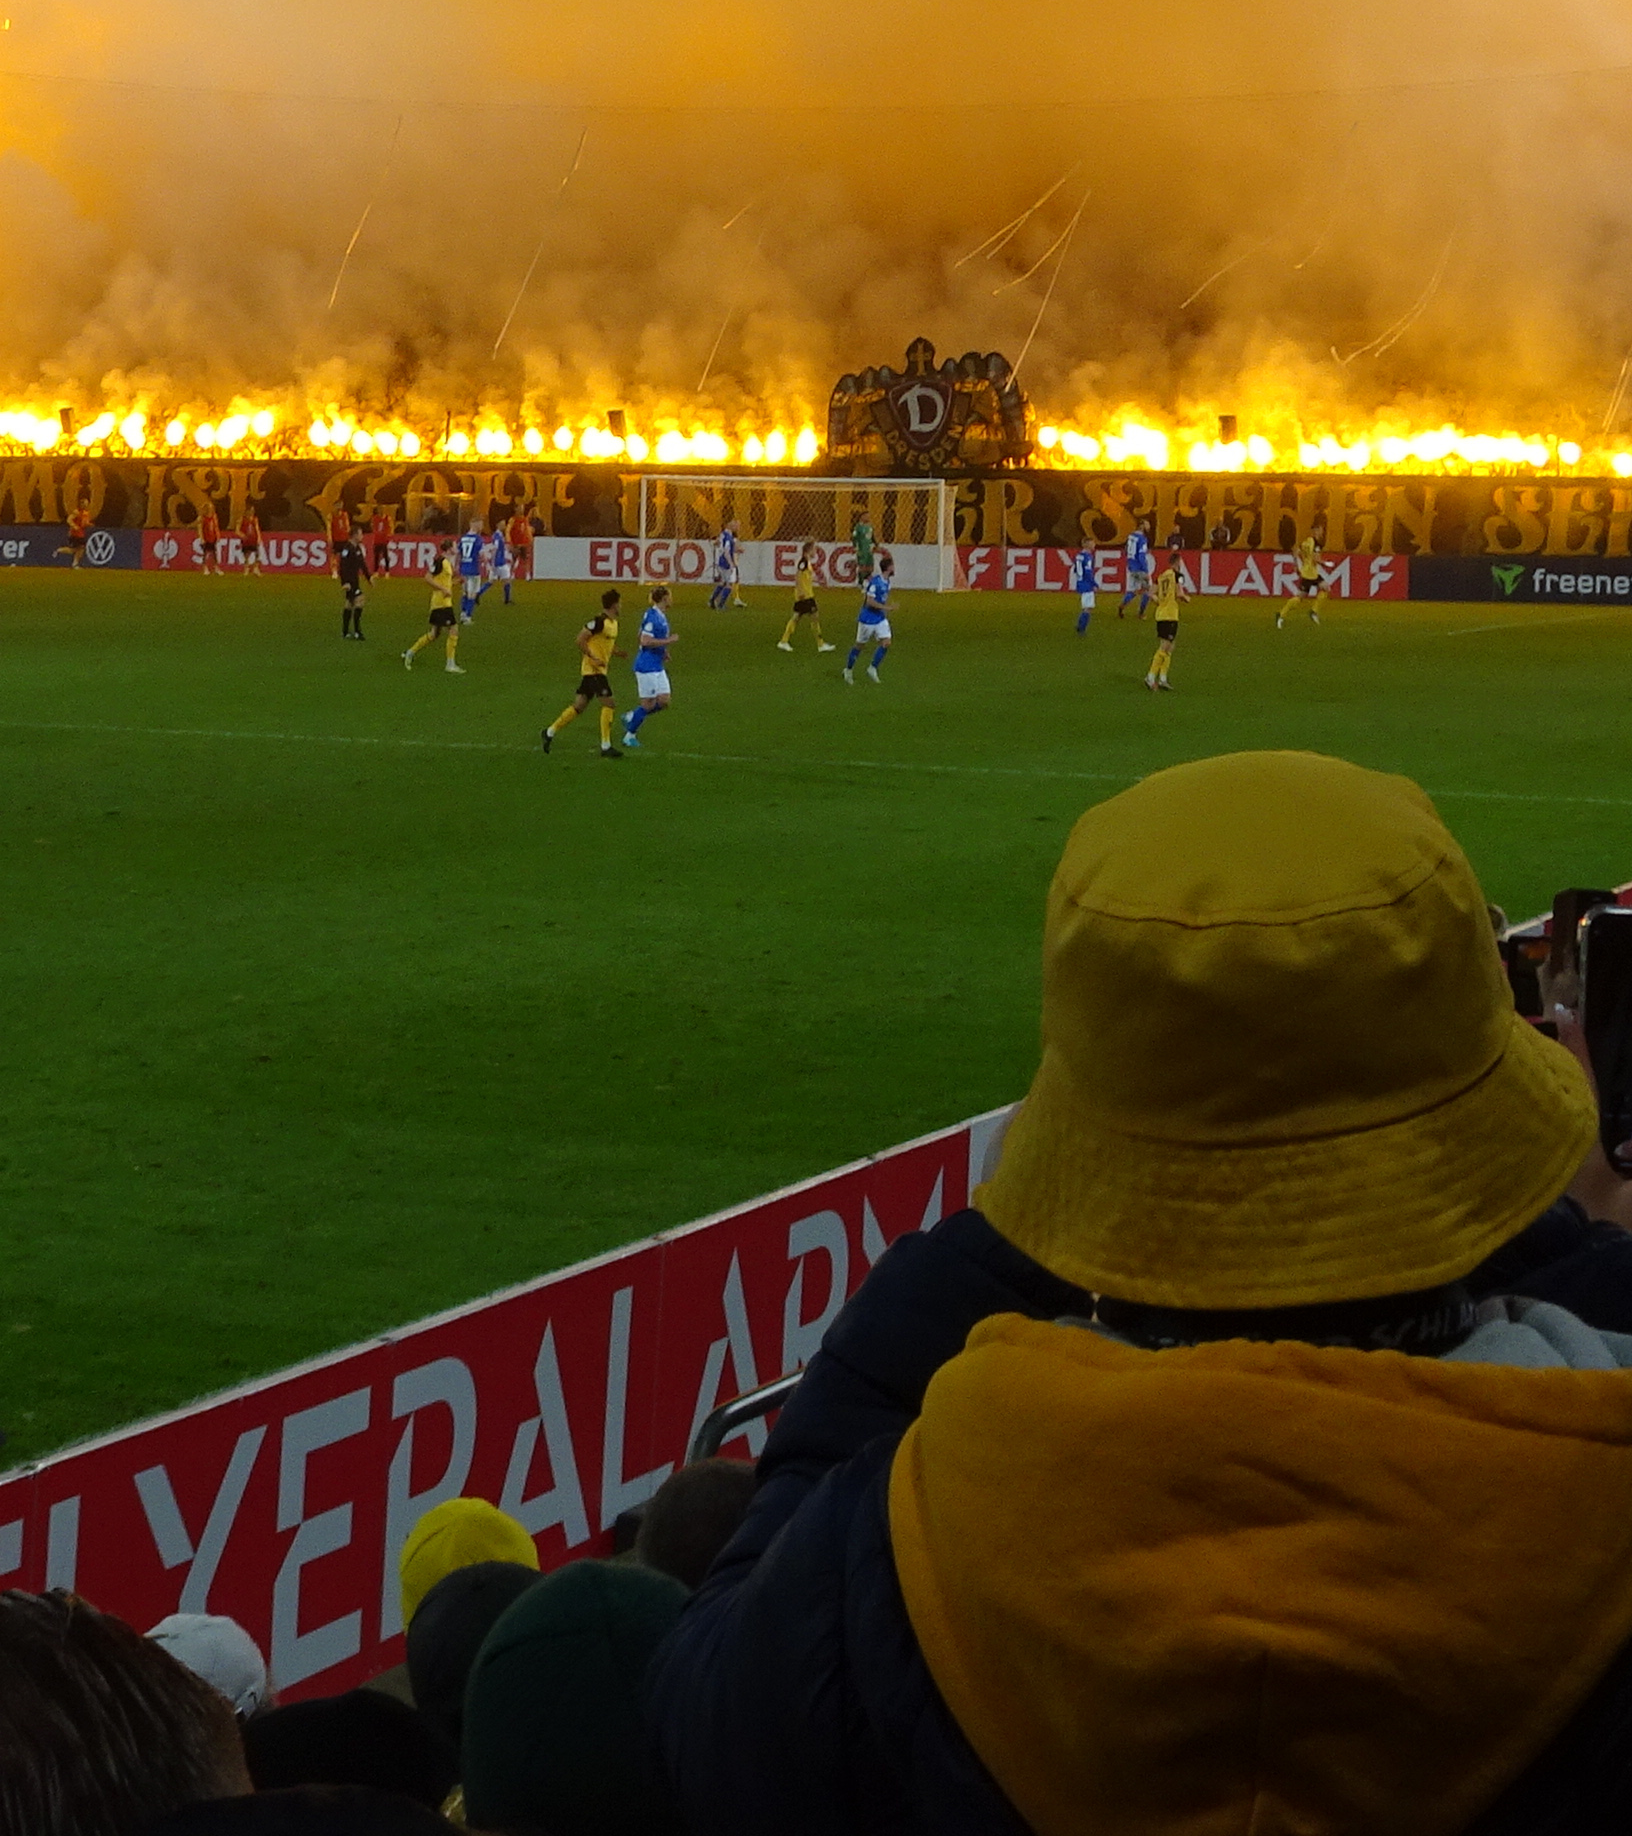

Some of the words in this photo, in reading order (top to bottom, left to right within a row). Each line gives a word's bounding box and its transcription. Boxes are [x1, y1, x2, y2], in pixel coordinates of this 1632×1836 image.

[885, 423, 965, 471] DRESDEN
[144, 463, 268, 530] IST
[1079, 478, 1438, 556] STEHEN
[190, 537, 328, 567] STRAUSS
[589, 540, 706, 580] ERGO
[1006, 547, 1351, 598] FLYEALARM
